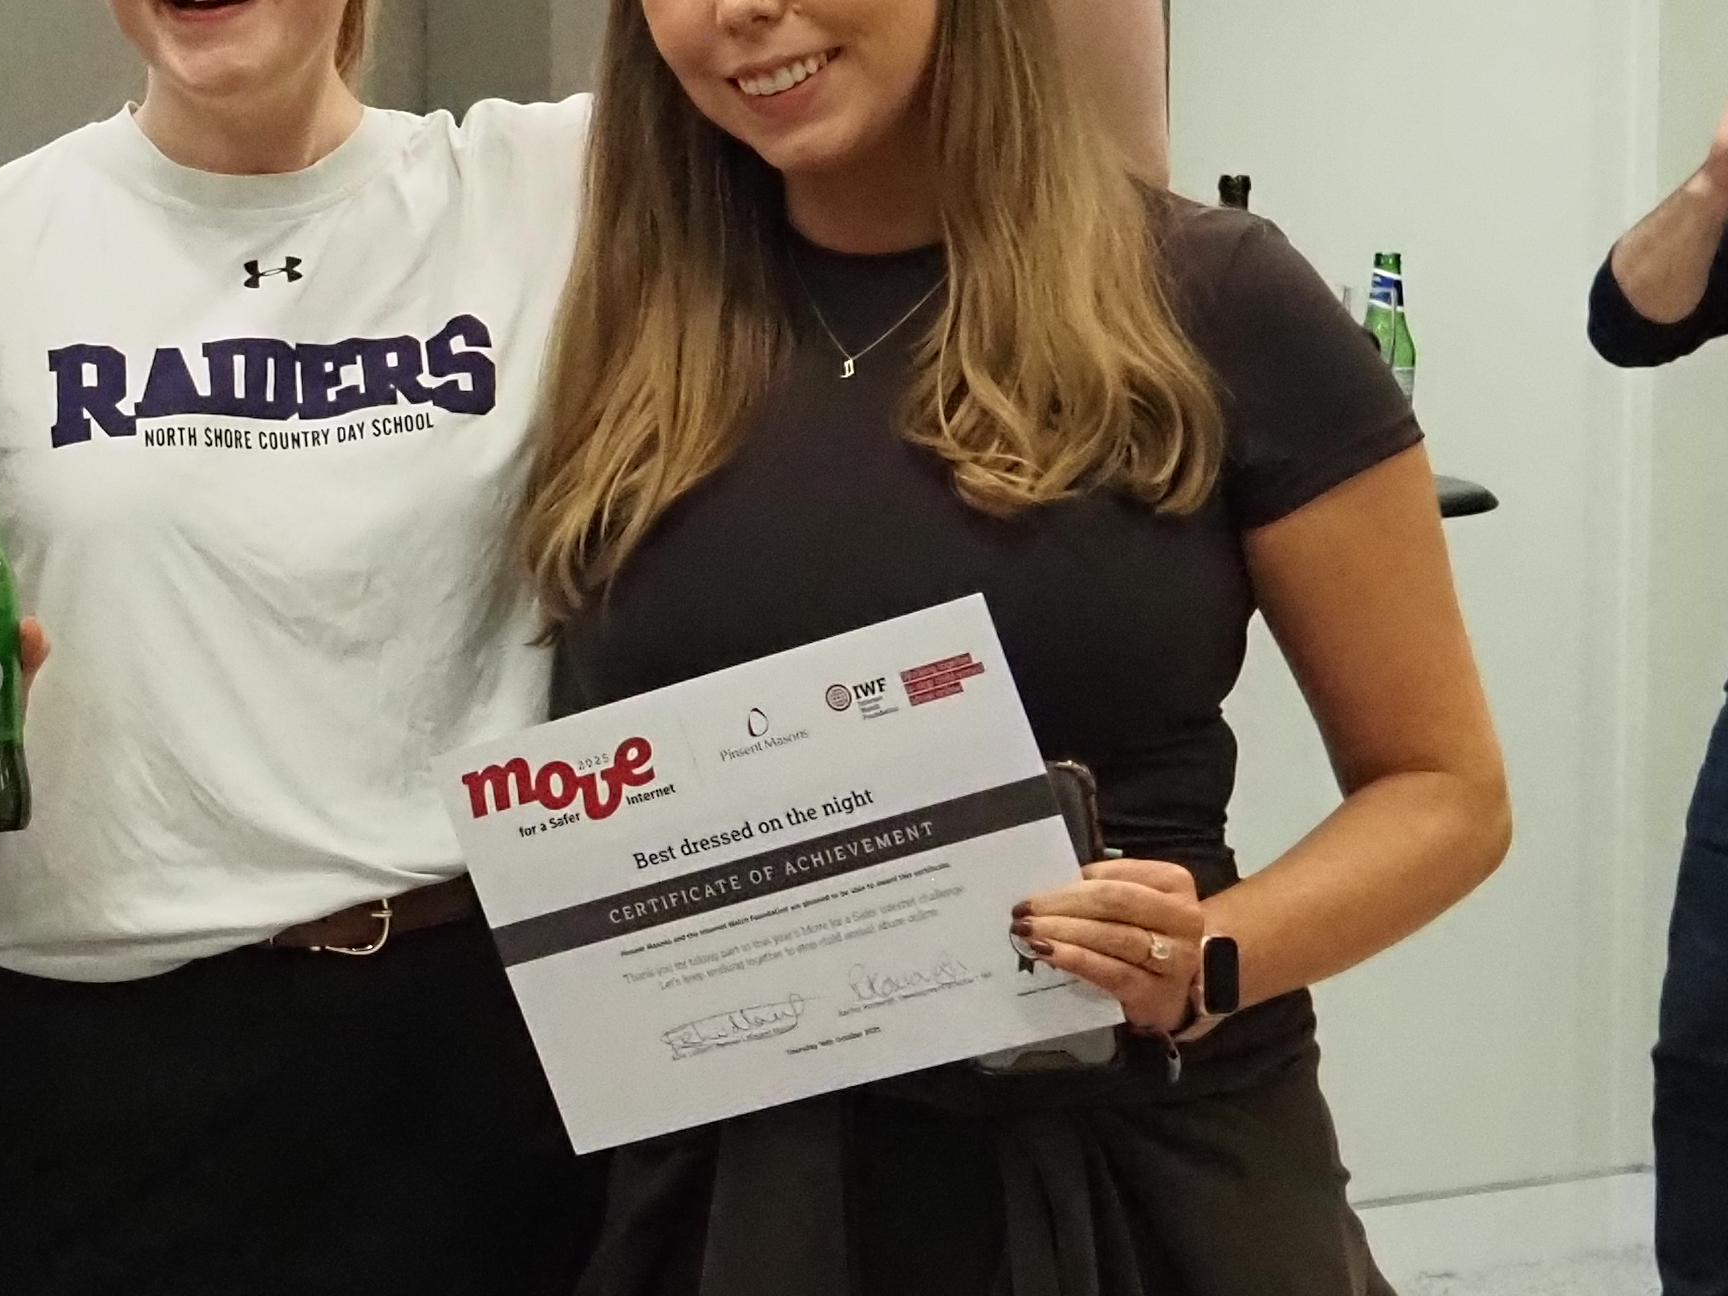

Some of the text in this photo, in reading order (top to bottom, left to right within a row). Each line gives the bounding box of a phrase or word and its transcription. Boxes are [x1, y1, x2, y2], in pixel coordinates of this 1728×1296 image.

[47, 313, 497, 448] RAIDERS
[144, 412, 434, 450] NORTH SHORE COUNTRY DAY SCHOOL
[852, 676, 885, 699] IWF
[461, 736, 655, 821] move
[719, 729, 808, 762] Pinsent Masons
[518, 783, 676, 837] for a Safer Internet
[632, 789, 873, 869] Best dressed on the night
[608, 875, 741, 923] CERTIFICATE
[748, 865, 773, 884] OF
[785, 821, 931, 875] ACHIEVEMENT
